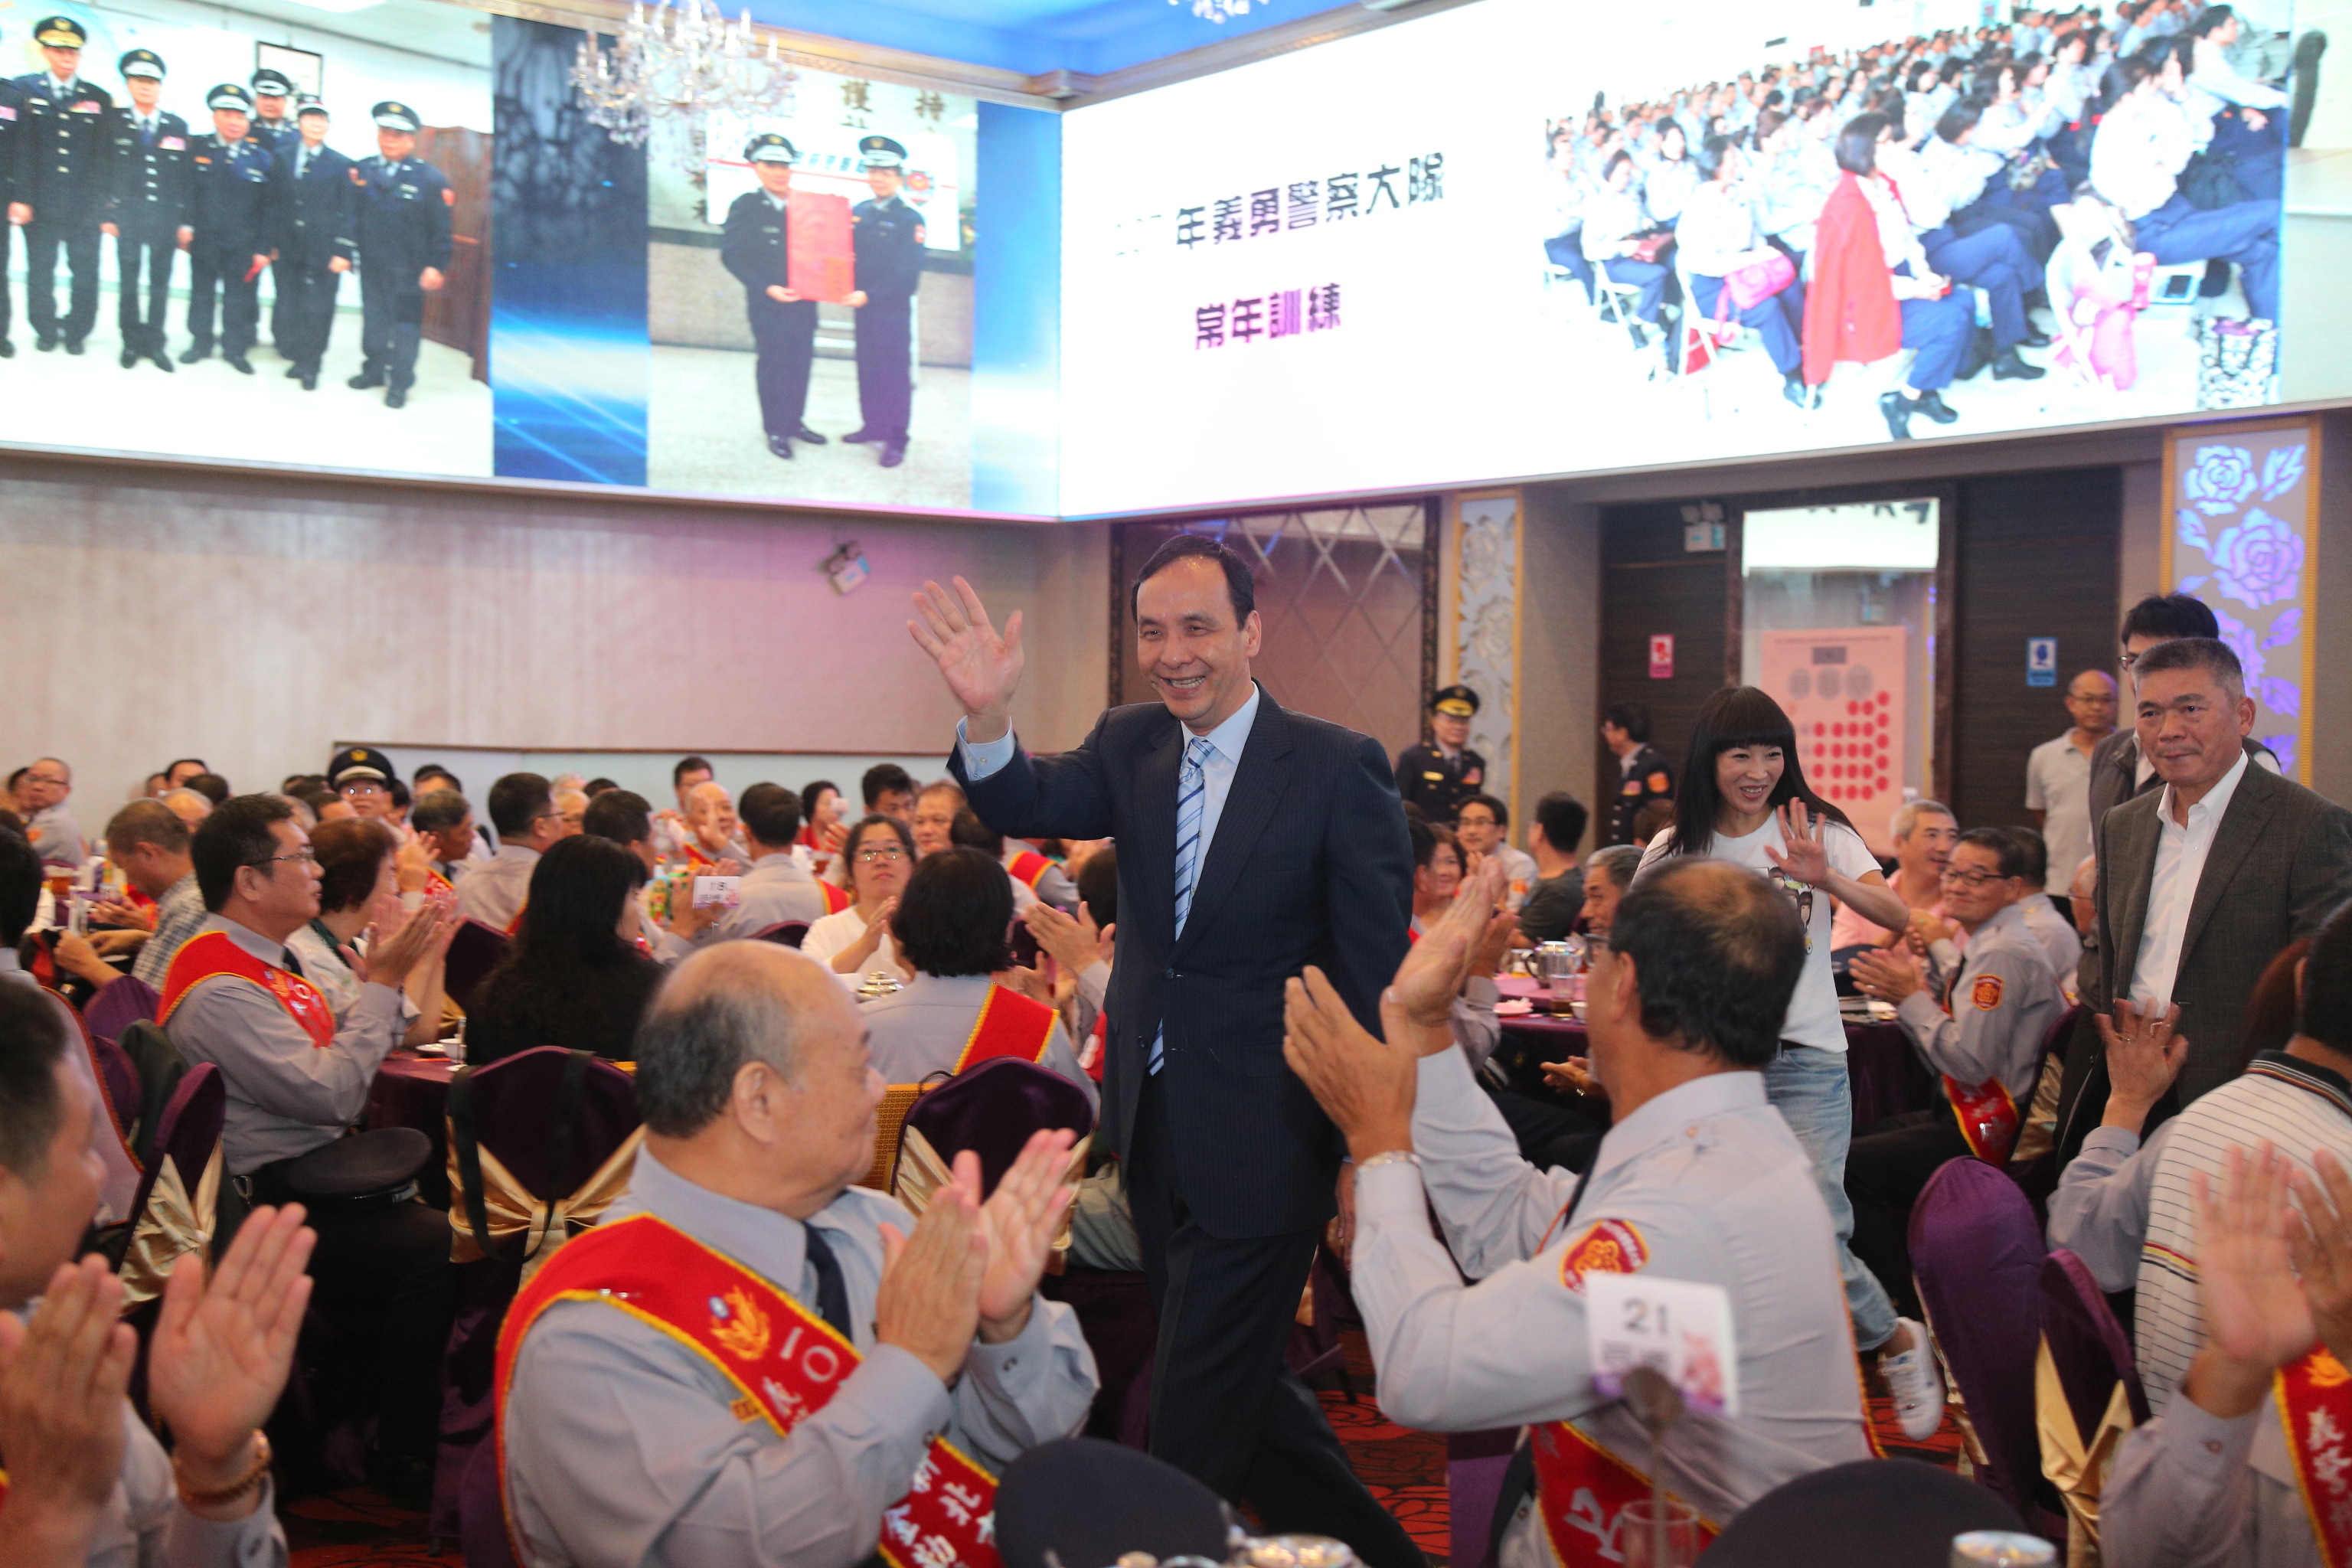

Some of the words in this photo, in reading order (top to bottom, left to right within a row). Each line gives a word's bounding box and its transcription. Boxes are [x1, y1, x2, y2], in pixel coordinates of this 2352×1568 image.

[1116, 152, 1446, 256] 年義勇警察大隊
[1195, 282, 1342, 350] 常年訓練
[1624, 1298, 1668, 1335] 21
